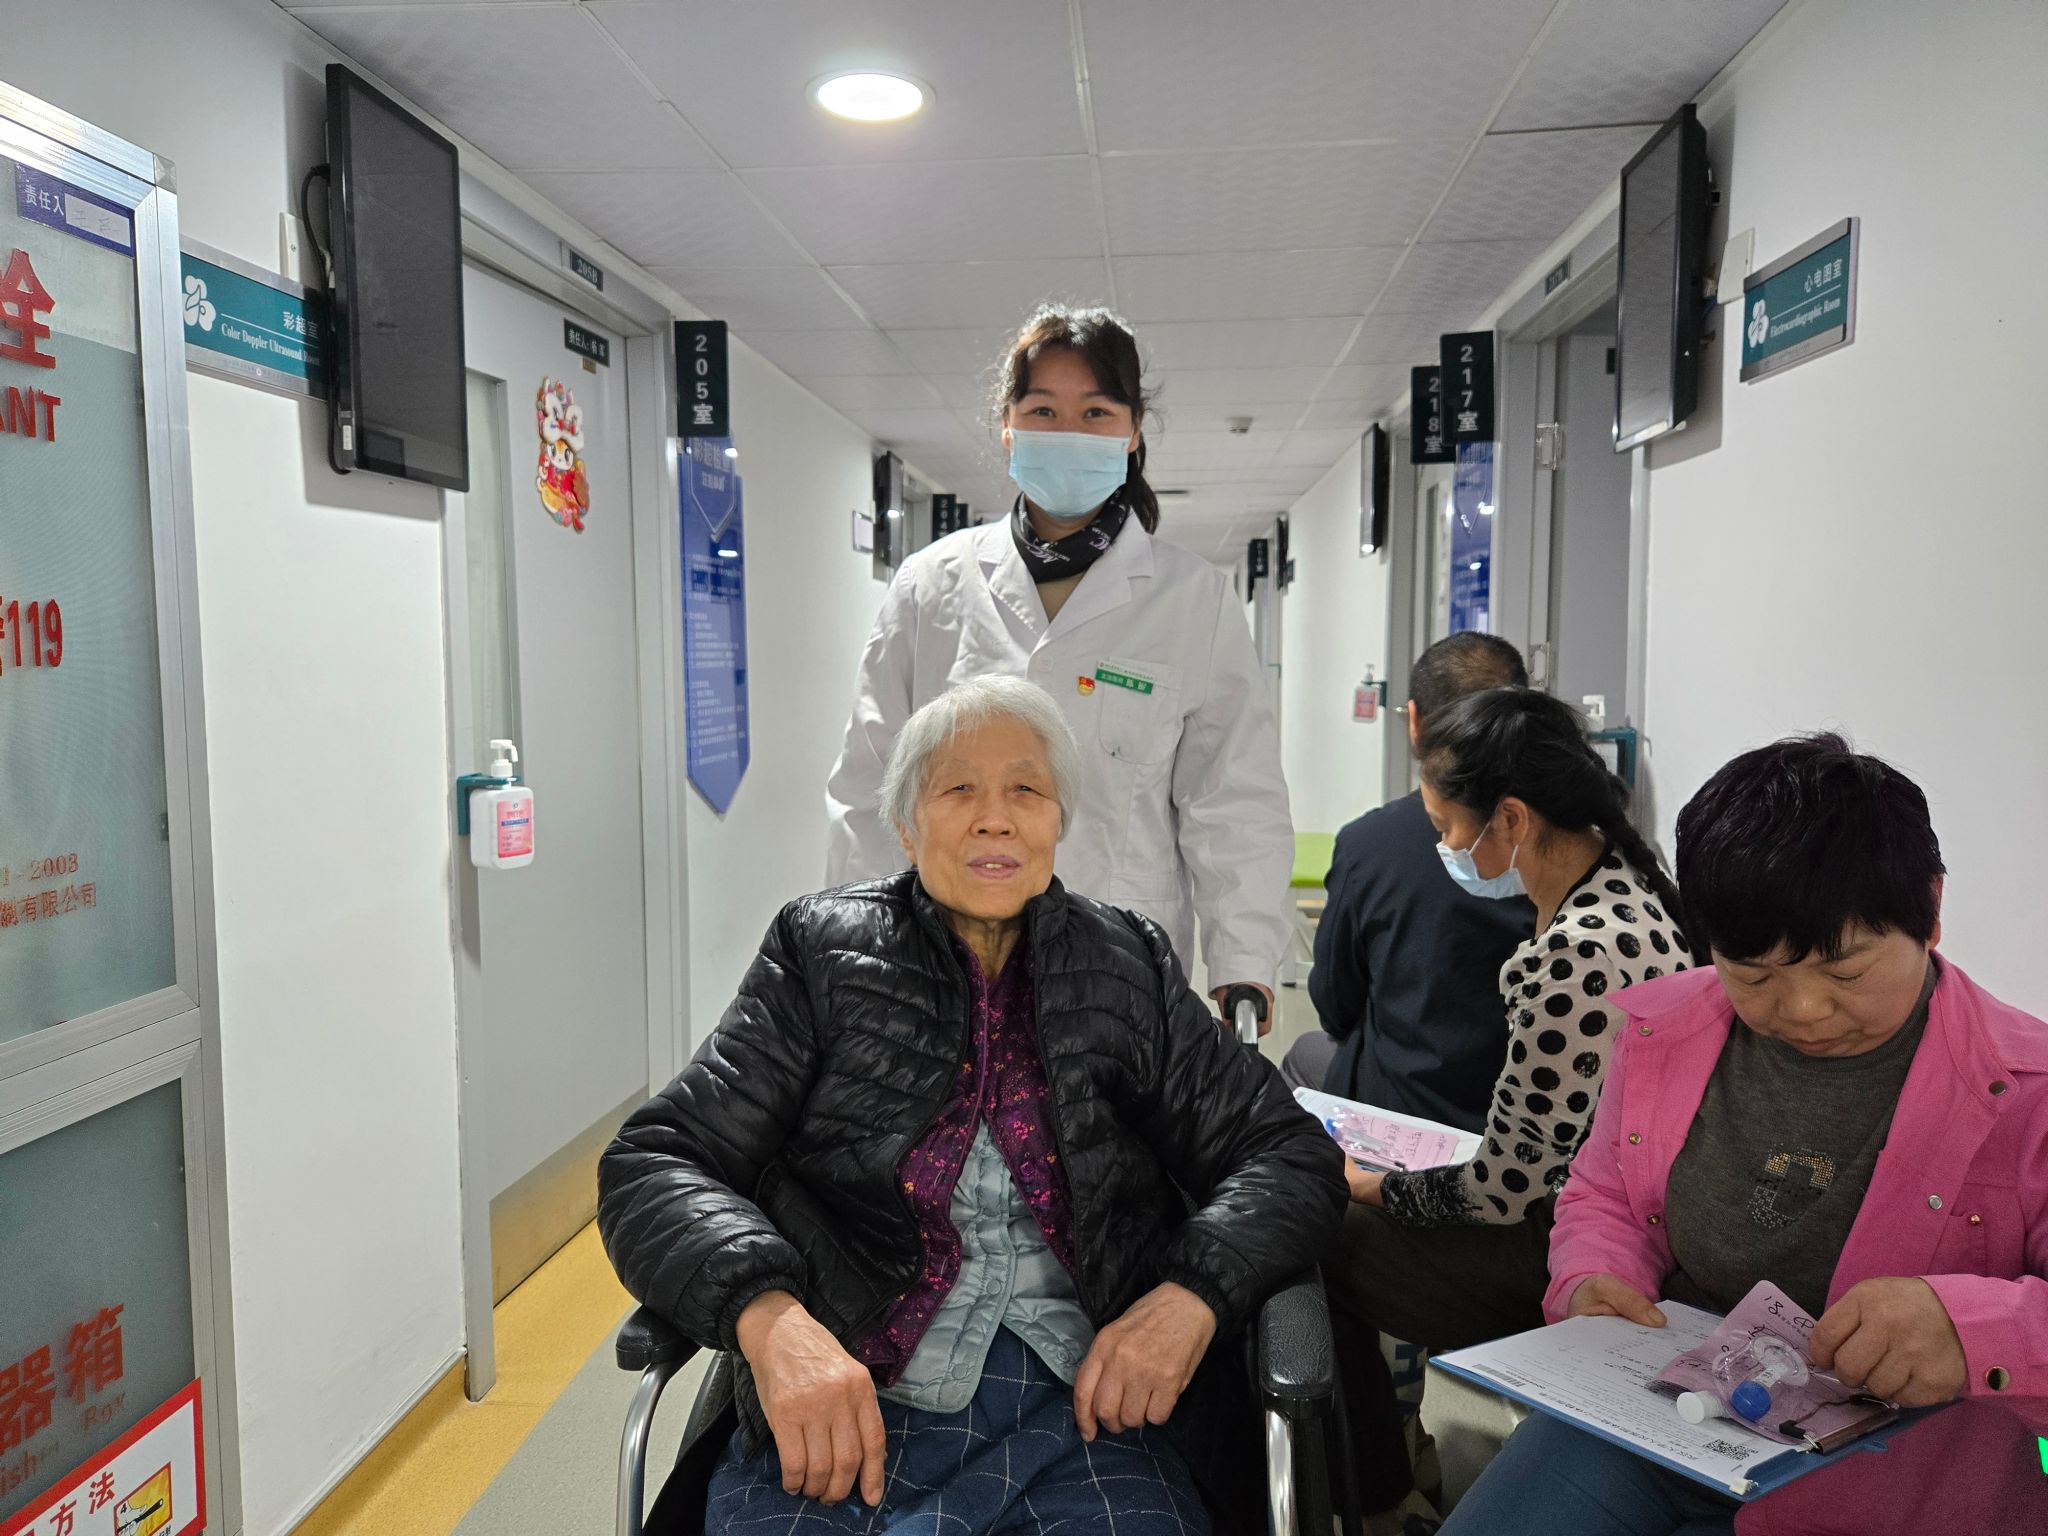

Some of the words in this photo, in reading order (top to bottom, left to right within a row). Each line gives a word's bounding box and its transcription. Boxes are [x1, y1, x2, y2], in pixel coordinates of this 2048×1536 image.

[24, 184, 65, 217] 责任人
[1803, 258, 1843, 293] 心电图室
[282, 310, 320, 339] 彩超室
[1823, 298, 1842, 313] Room
[221, 322, 241, 341] Color
[242, 329, 269, 350] Doppler
[269, 338, 303, 361] Ultrasound
[692, 334, 715, 425] 205室
[1456, 344, 1479, 432] 217室
[0, 385, 61, 442] NT
[22, 1471, 116, 1536] 方法
